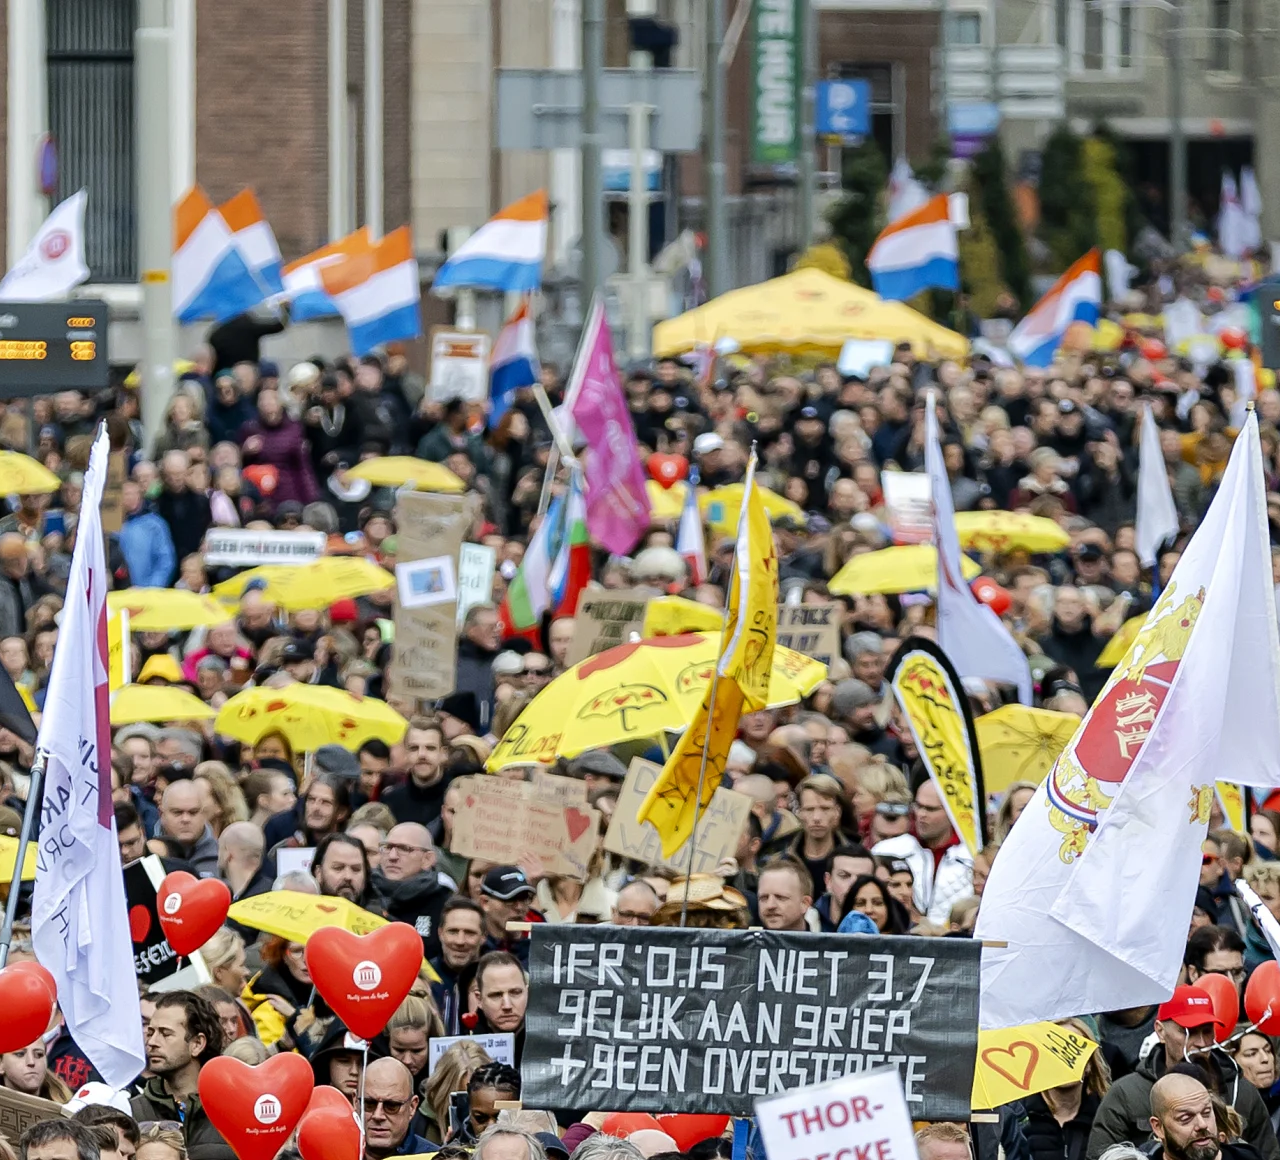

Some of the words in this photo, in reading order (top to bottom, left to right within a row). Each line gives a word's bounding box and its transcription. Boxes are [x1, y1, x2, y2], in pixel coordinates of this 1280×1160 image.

[758, 948, 848, 996] NIET
[867, 954, 935, 1003] 3.7
[698, 999, 782, 1044] AAN
[550, 1044, 586, 1085] +
[780, 1096, 884, 1139] THOR-
